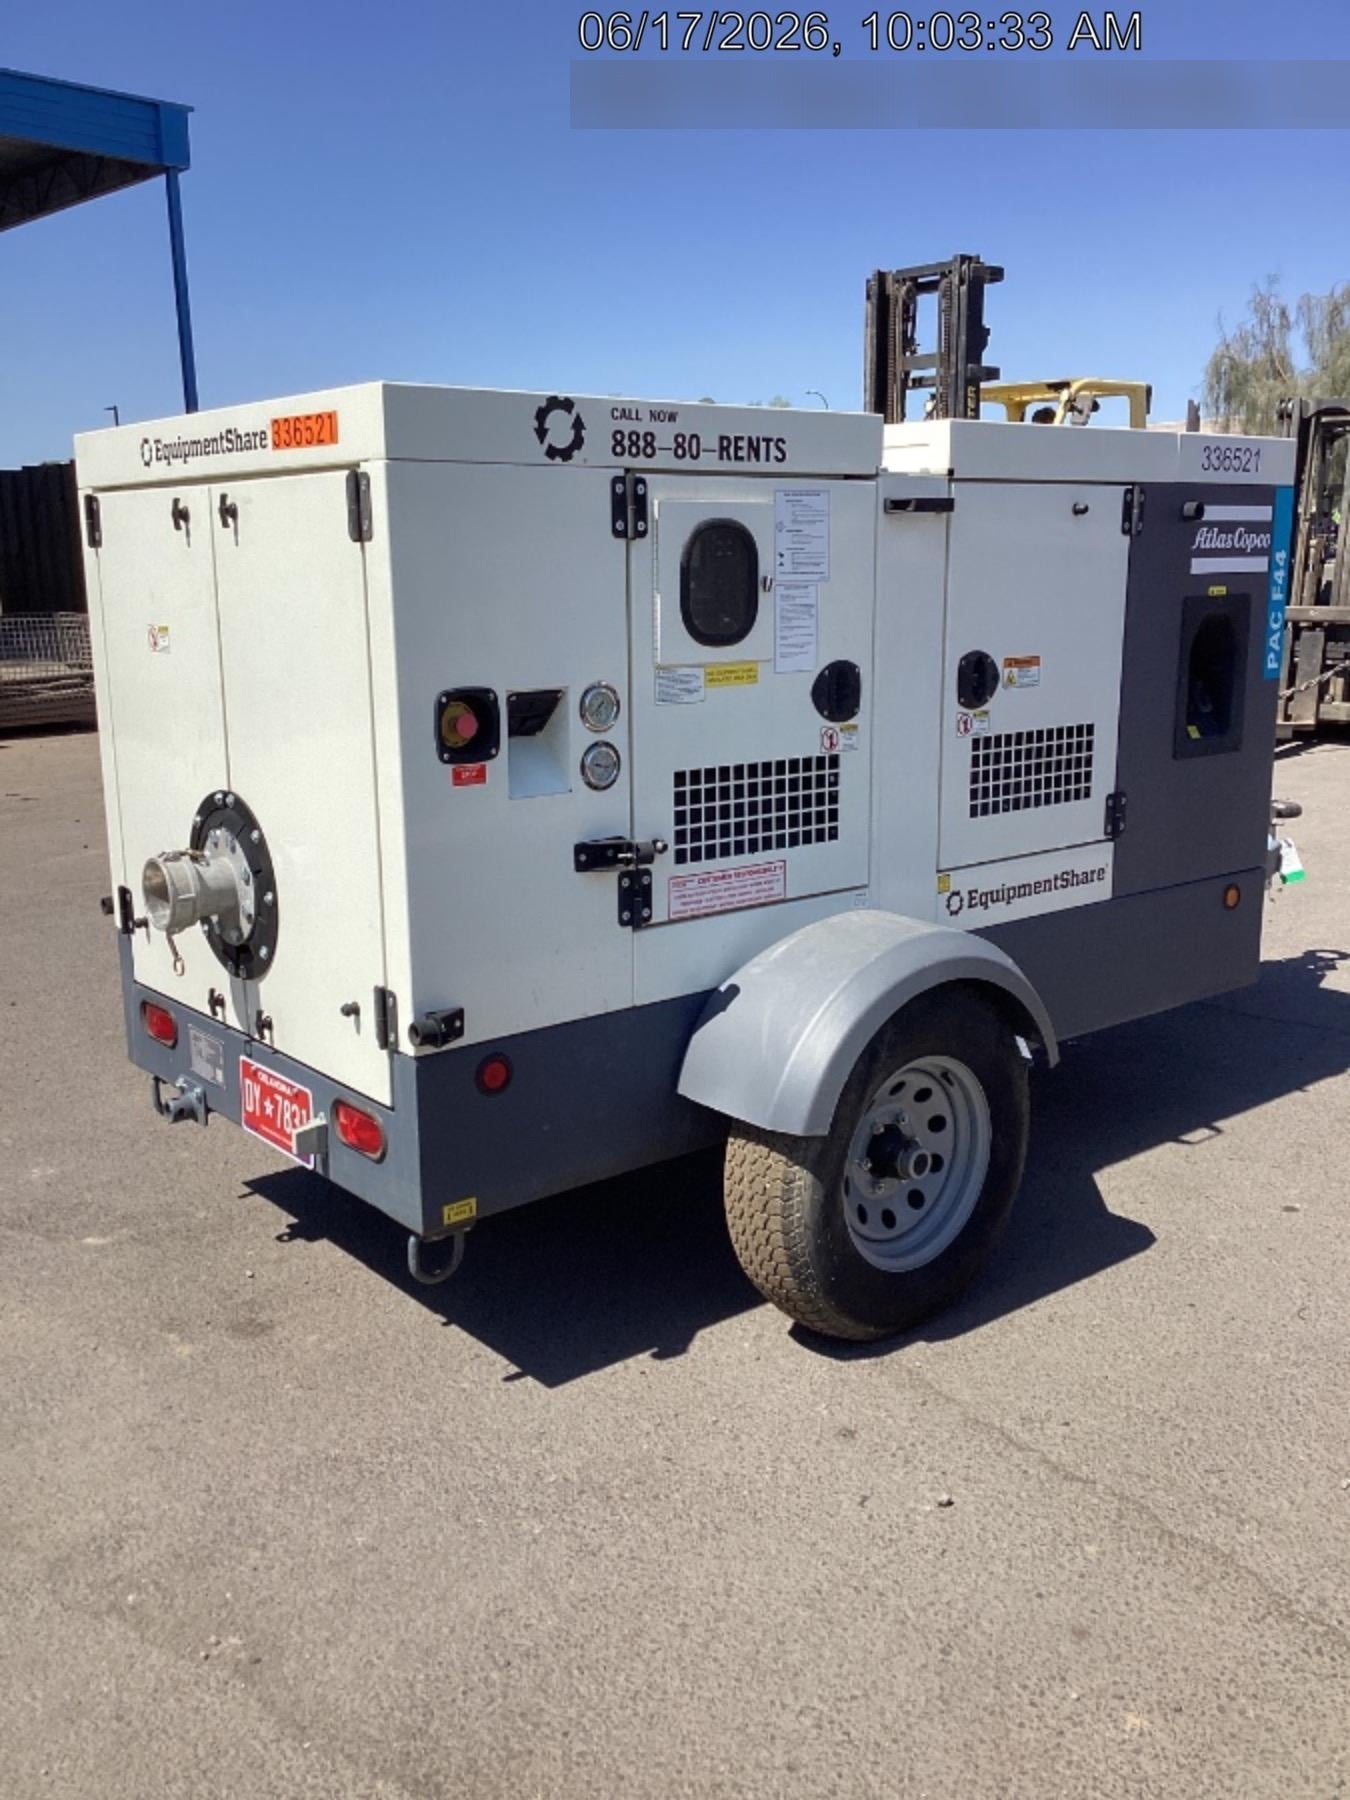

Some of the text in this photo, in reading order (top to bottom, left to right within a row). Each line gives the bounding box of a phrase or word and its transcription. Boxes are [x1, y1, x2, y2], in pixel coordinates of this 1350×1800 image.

[272, 413, 335, 449] 336521
[611, 407, 679, 423] CALL NOW
[154, 427, 268, 466] EquipmentShare
[611, 429, 787, 463] 888-80-RENTS
[1201, 445, 1261, 473] 336521
[1267, 551, 1288, 669] PAC F44
[967, 867, 1106, 910] EquipmentShare
